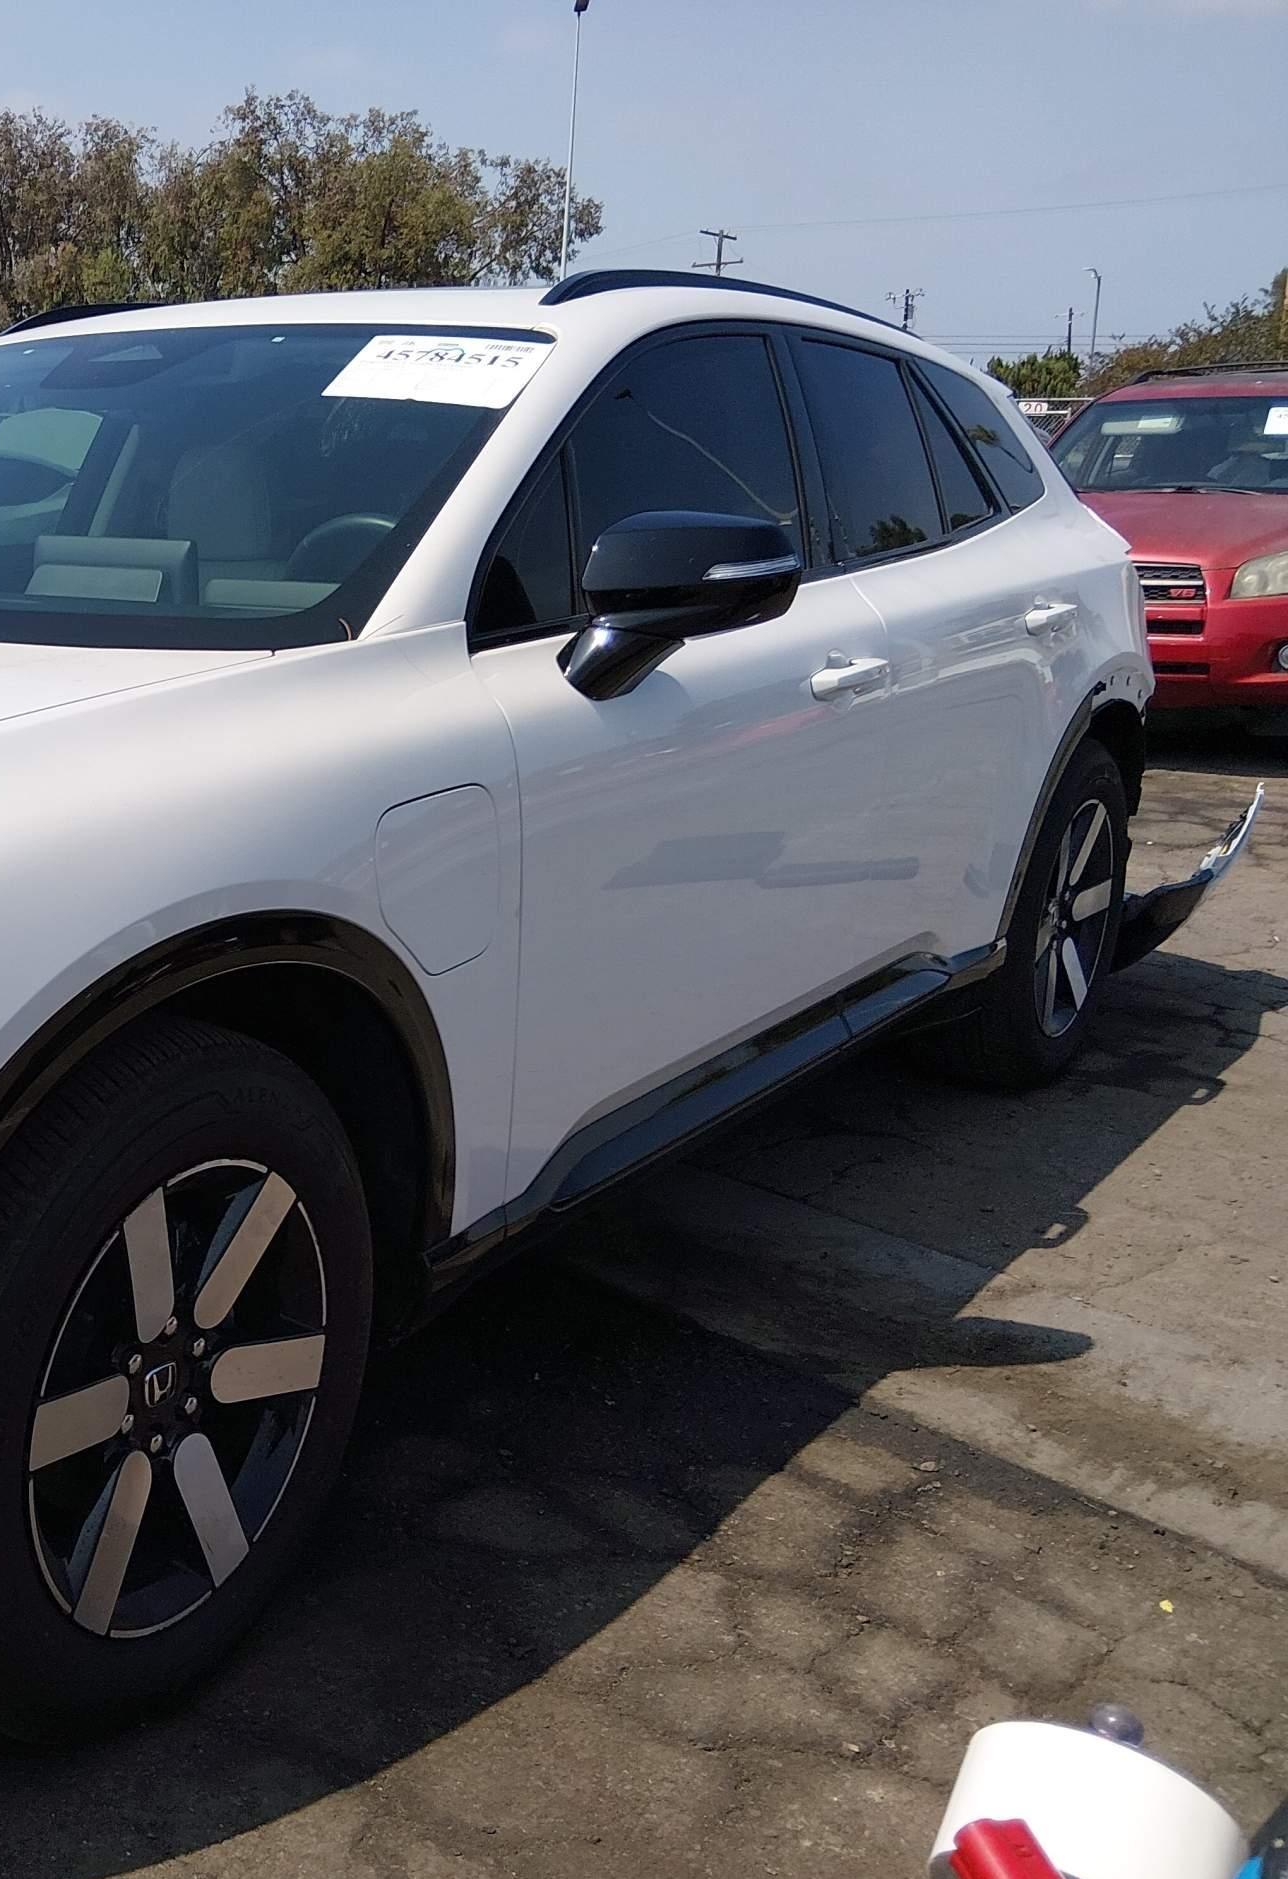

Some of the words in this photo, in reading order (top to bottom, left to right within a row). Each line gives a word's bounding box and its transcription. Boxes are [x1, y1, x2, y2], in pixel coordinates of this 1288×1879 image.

[375, 349, 525, 369] 45784515
[1023, 402, 1043, 412] 20
[1169, 588, 1196, 597] V6
